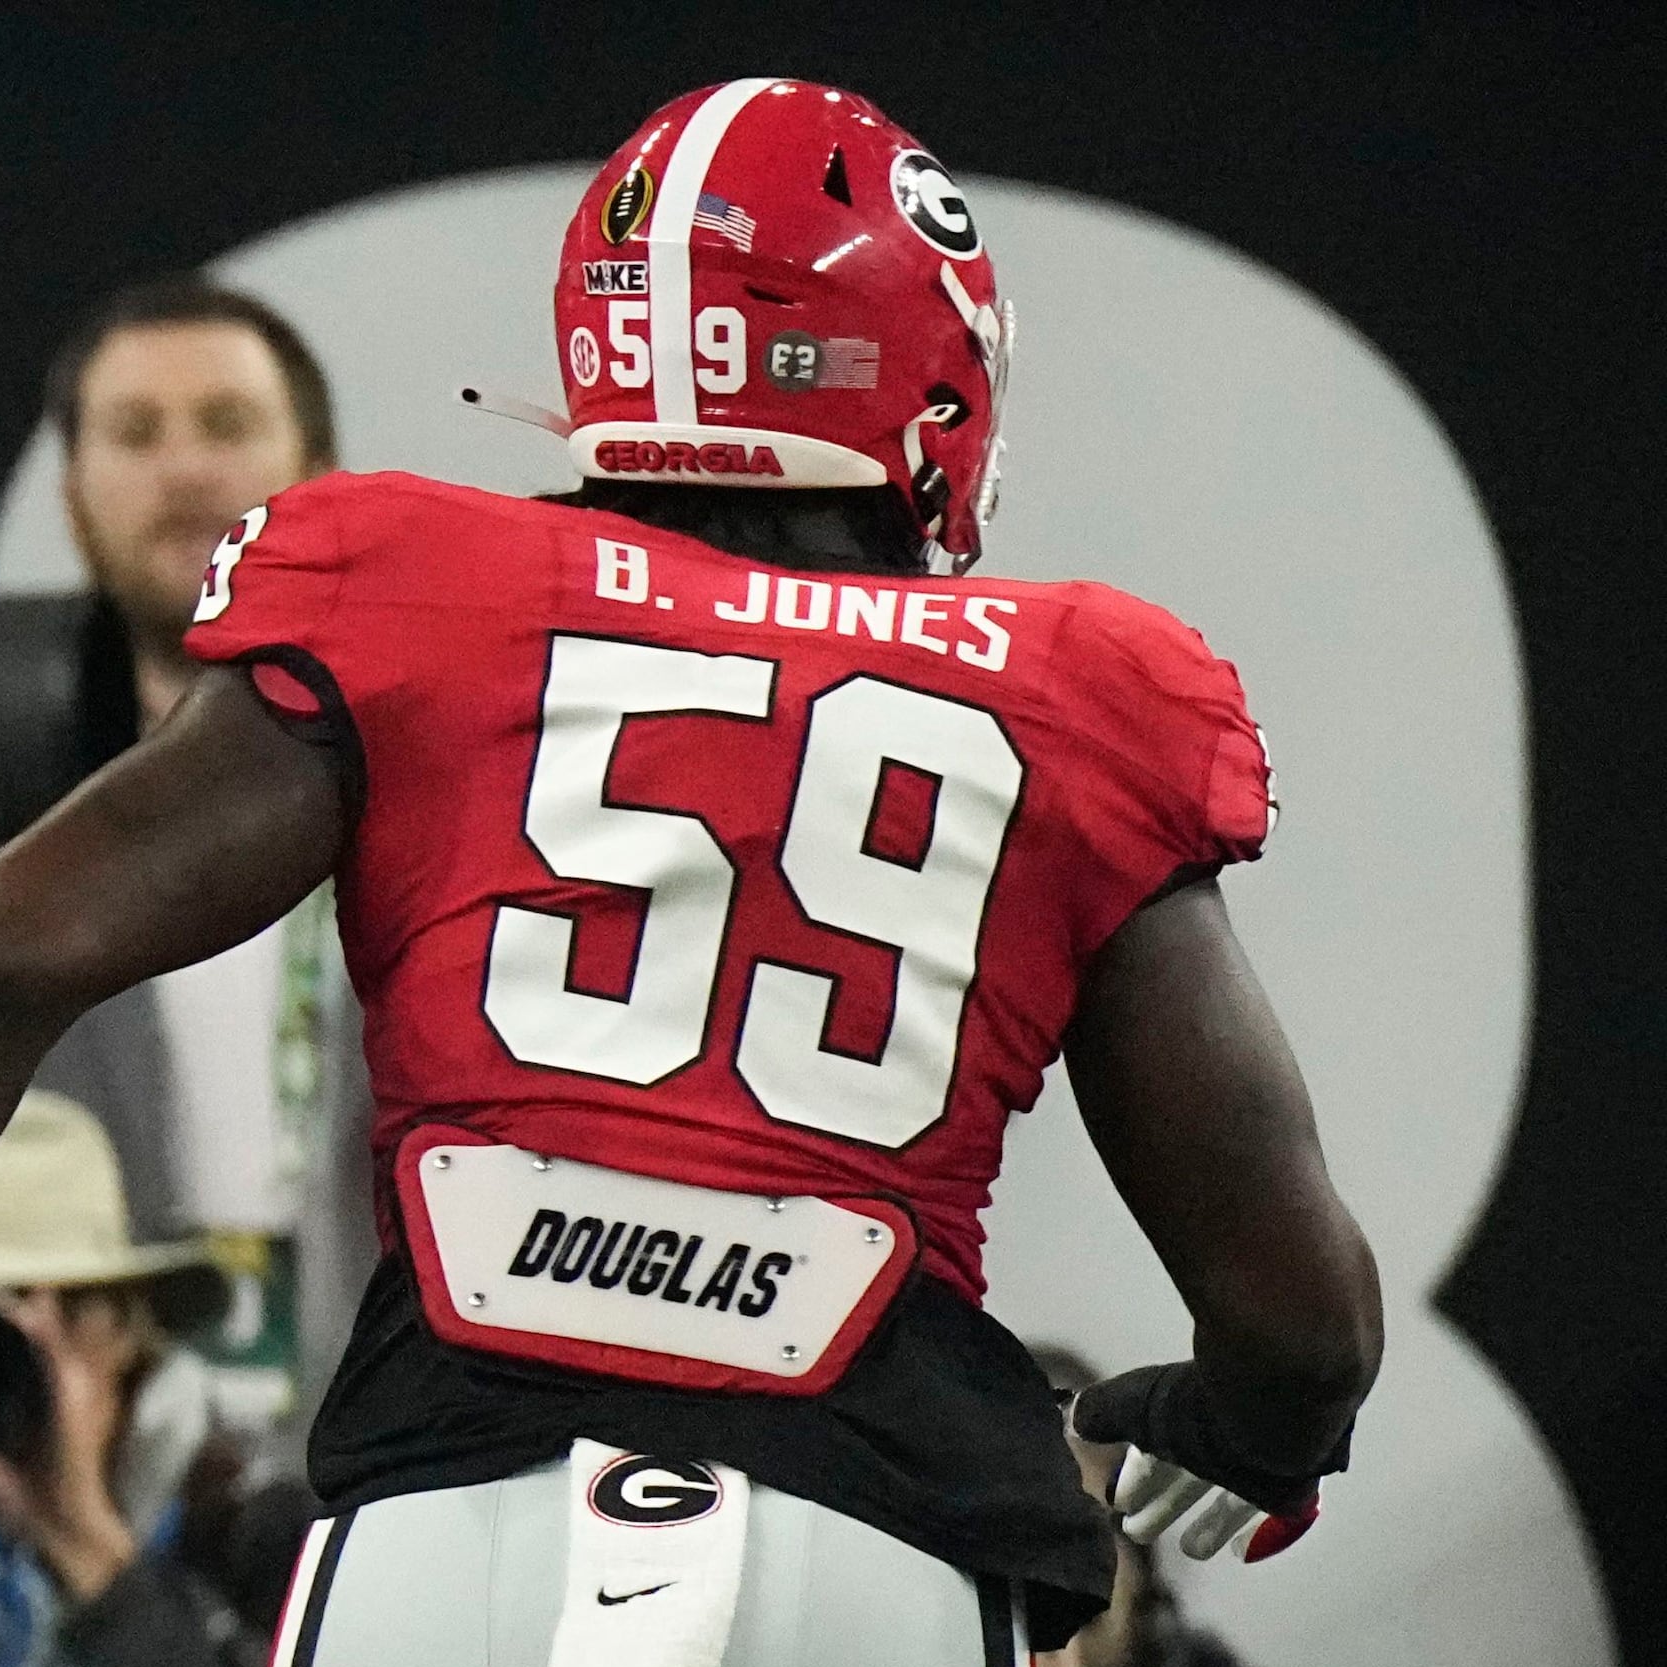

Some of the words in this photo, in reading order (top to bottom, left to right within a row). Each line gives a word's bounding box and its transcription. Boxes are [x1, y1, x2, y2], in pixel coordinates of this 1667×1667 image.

[594, 440, 785, 477] GEORGIA
[595, 537, 675, 610] B.
[713, 570, 1018, 673] JONES
[484, 634, 1024, 1149] 59
[508, 1208, 793, 1318] DOUGLAS
